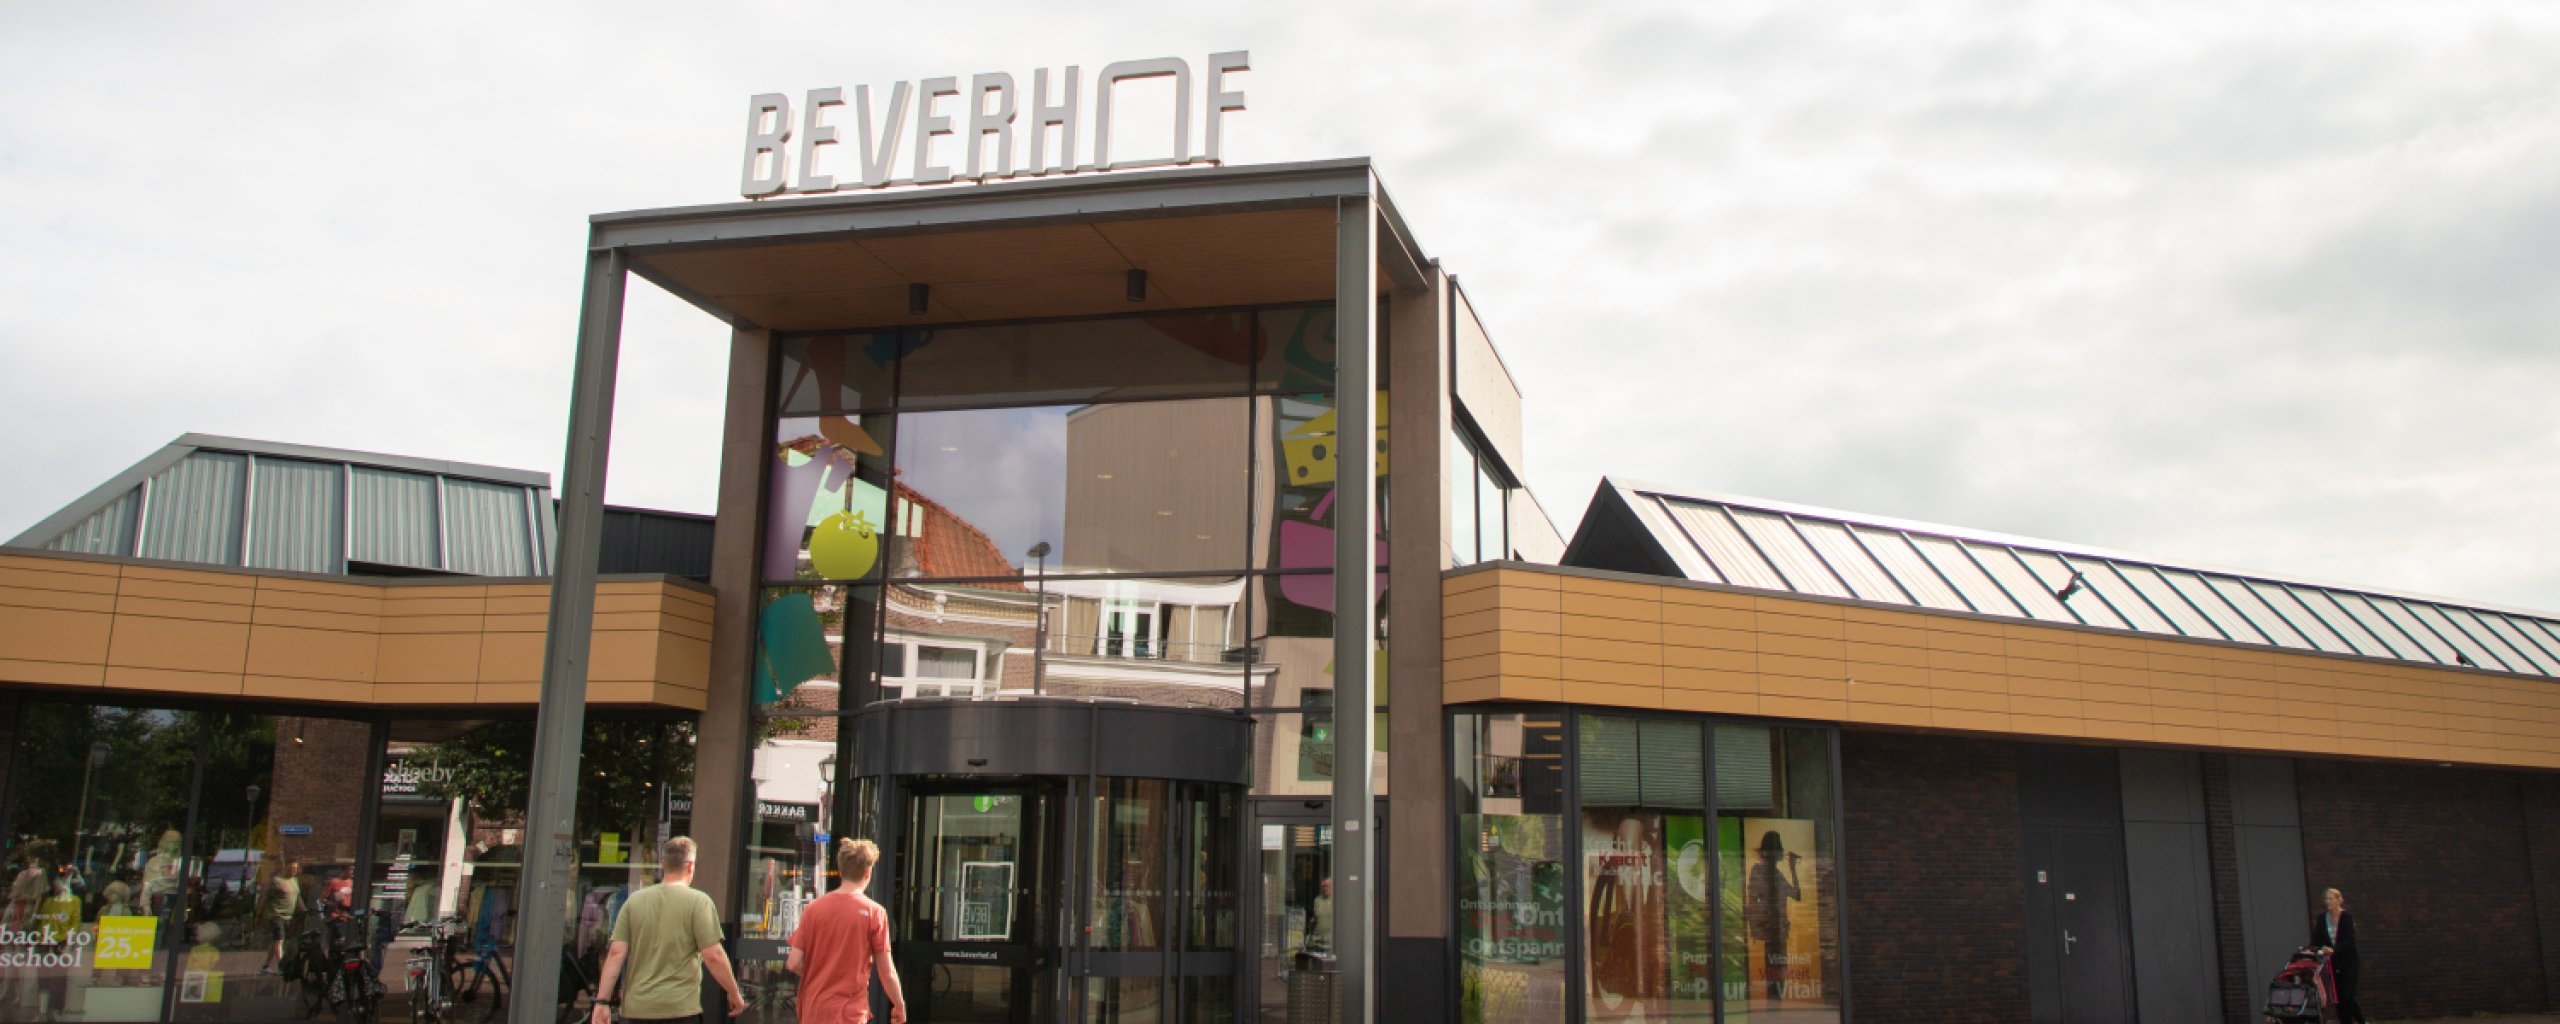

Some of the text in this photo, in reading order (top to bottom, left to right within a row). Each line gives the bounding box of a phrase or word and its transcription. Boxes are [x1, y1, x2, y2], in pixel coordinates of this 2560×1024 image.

[741, 50, 1251, 198] BEVERHOF
[0, 924, 58, 946] back
[67, 929, 91, 946] to
[0, 947, 83, 967] school
